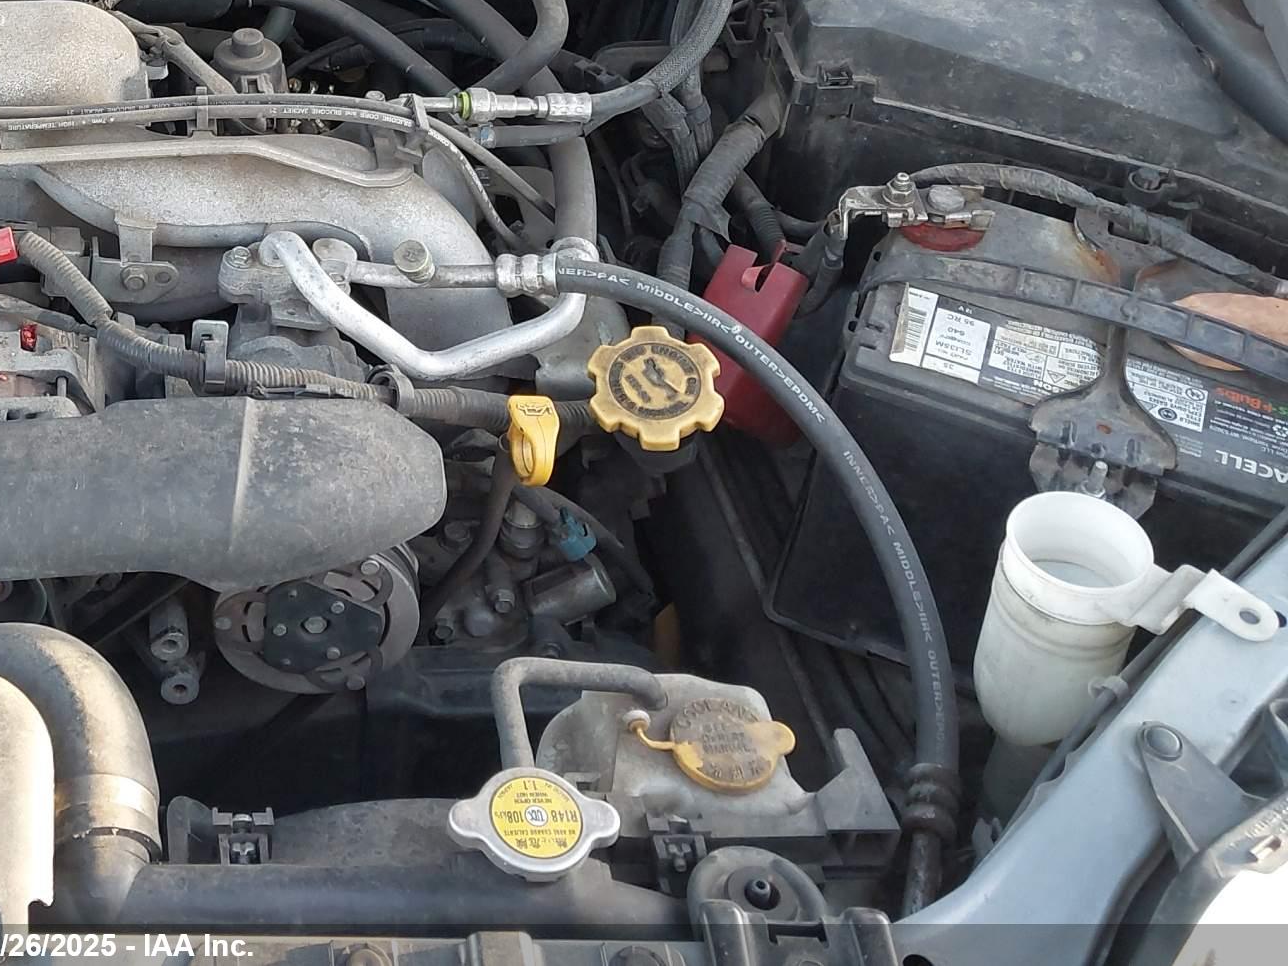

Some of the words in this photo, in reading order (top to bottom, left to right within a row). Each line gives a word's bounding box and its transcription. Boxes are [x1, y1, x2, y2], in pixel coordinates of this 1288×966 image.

[360, 112, 379, 120] CORE
[8, 121, 55, 131] TEMPERATURE
[946, 313, 962, 324] RC
[947, 326, 966, 336] 640
[522, 780, 538, 791] 1.1
[551, 809, 579, 823] R148
